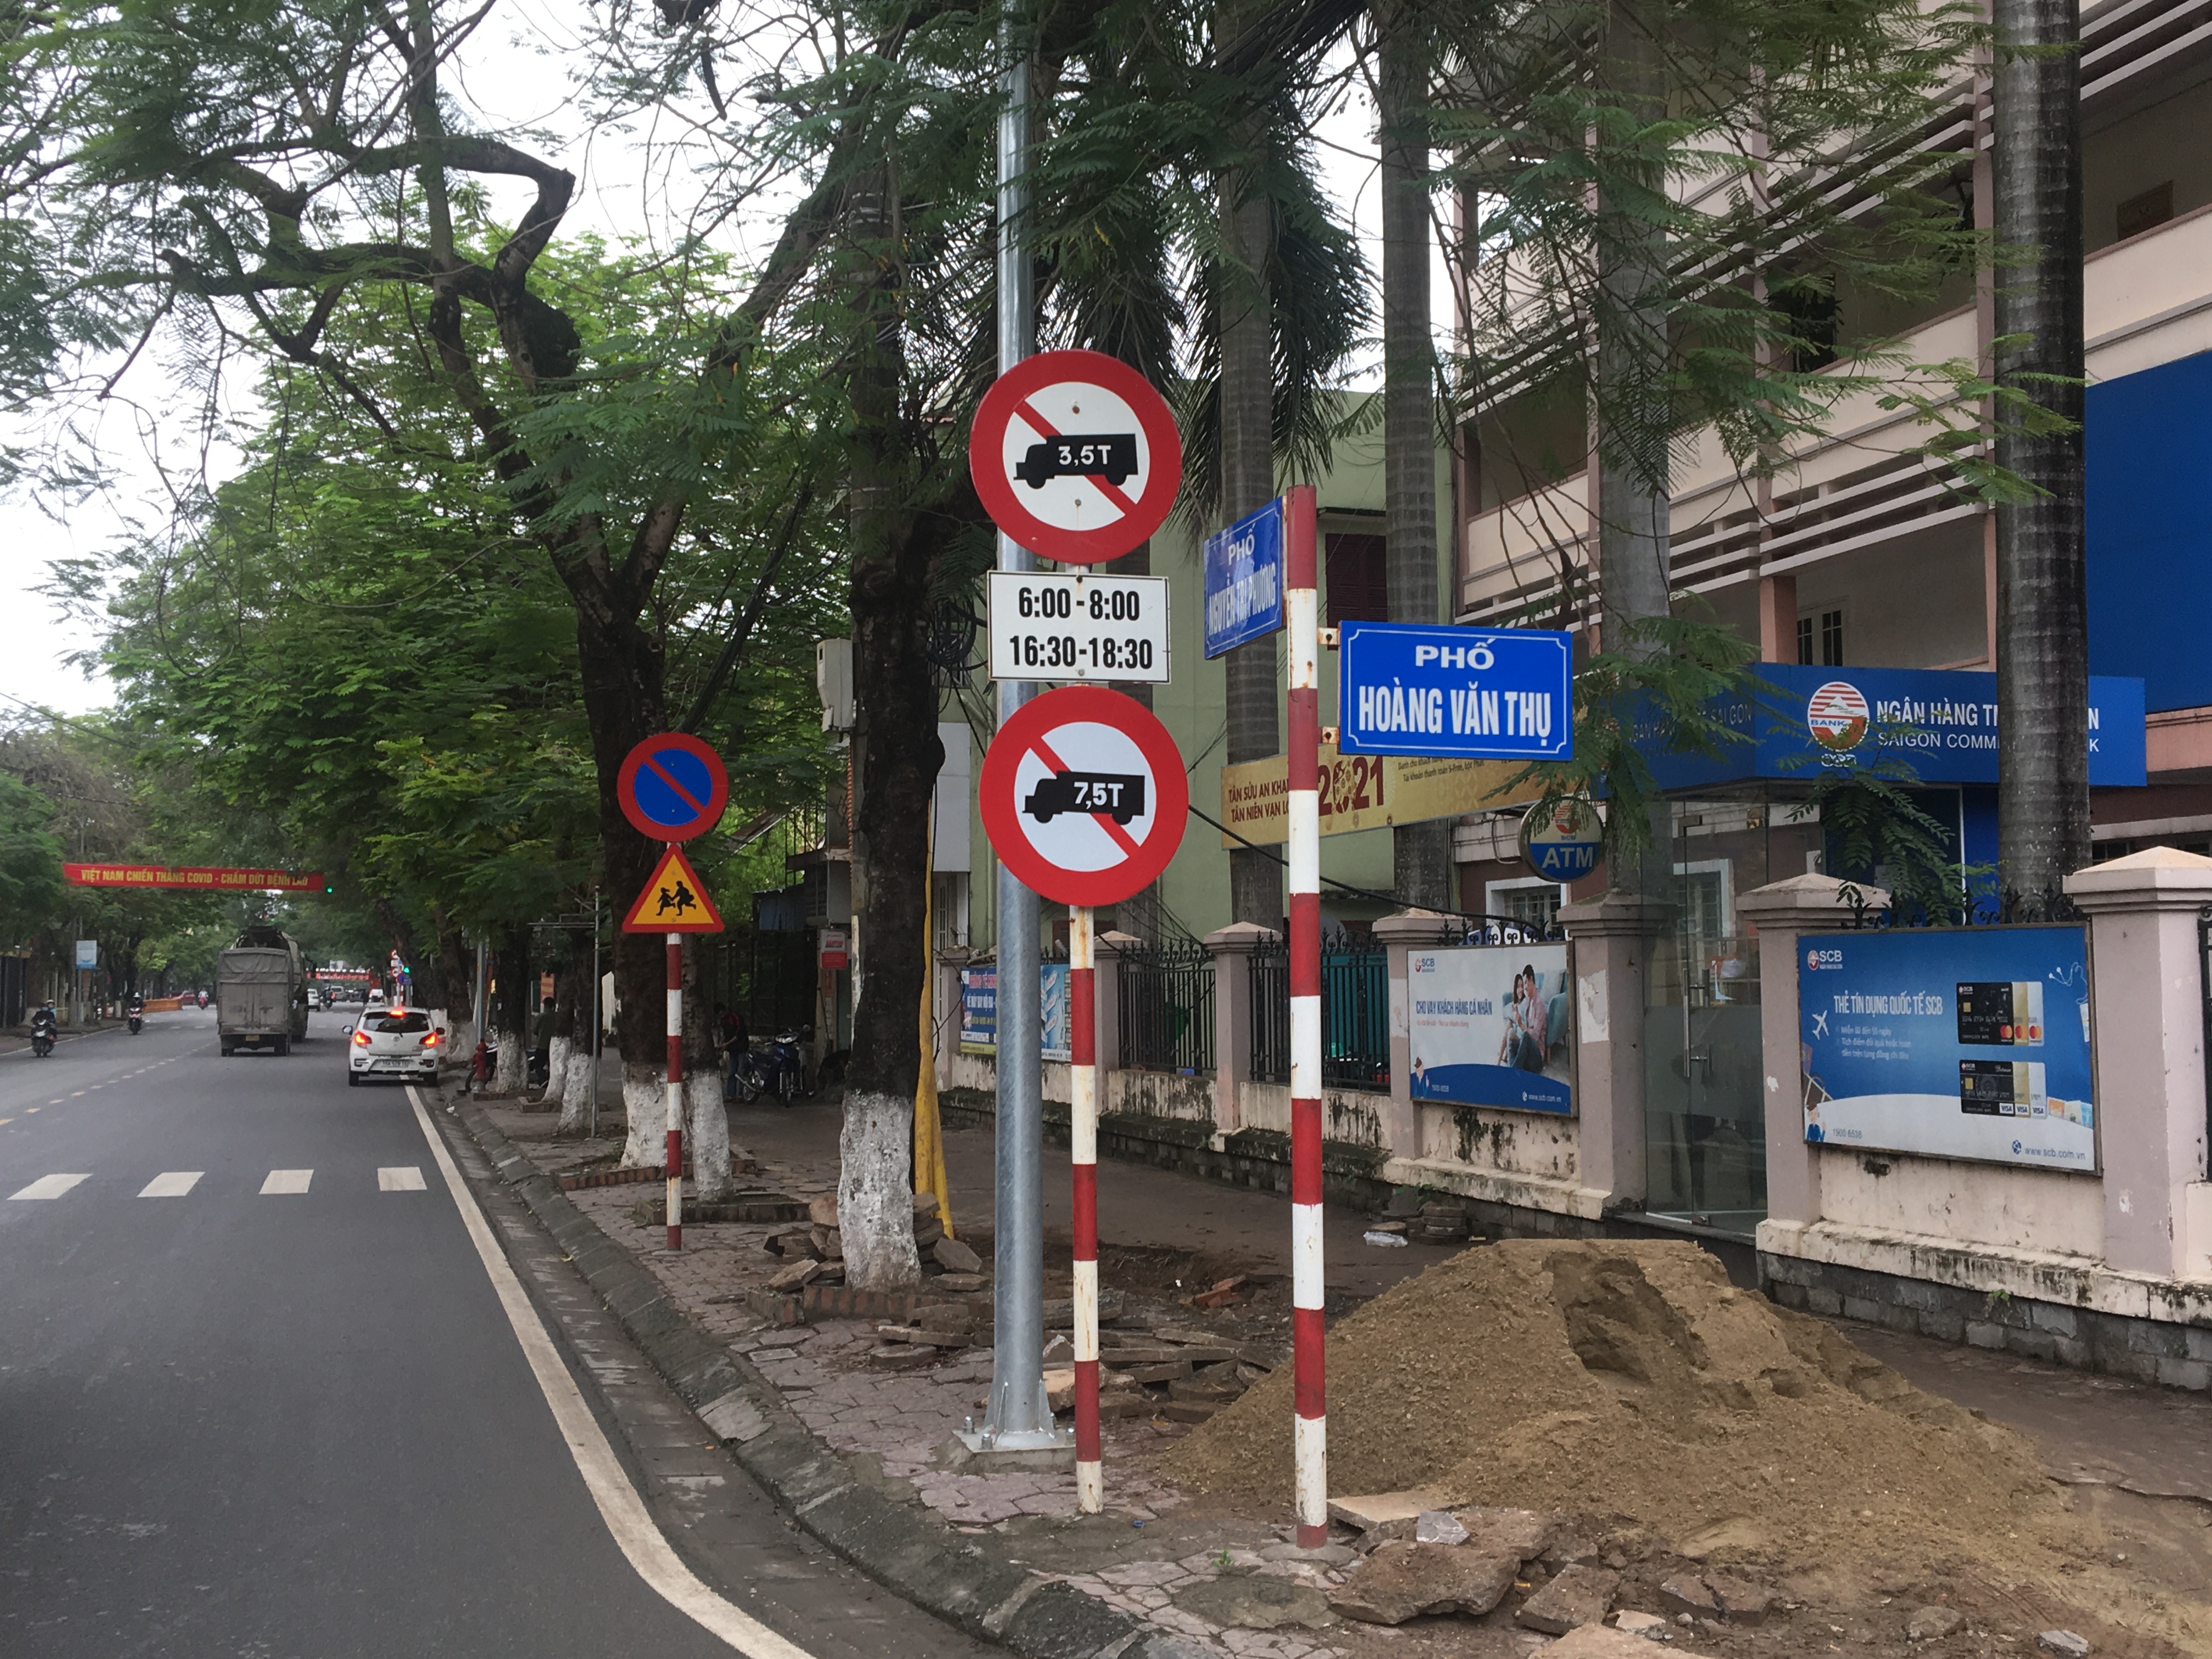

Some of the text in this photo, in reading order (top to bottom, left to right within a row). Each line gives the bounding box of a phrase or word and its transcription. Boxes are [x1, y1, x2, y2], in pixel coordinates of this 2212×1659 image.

[1058, 445, 1111, 466] 3,5T
[1228, 522, 1255, 566] PHỐ
[1415, 638, 1496, 670] PHỐ
[1359, 676, 1551, 746] HOÀNG VĂN THỤ
[1877, 696, 1925, 724] NGÂN
[1930, 697, 1978, 726] HÀNG
[1877, 732, 1941, 747] SAIGON
[1074, 782, 1124, 809] 7,5T
[1229, 784, 1243, 803] TÂN
[1259, 783, 1270, 797] AN
[1271, 778, 1289, 795] KHA
[1231, 805, 1245, 822] TÂN
[1542, 847, 1594, 868] ATM
[81, 867, 101, 883] VIỆT
[103, 871, 124, 881] NAM
[187, 872, 213, 883] COVID
[1421, 958, 1435, 967] SCB
[1819, 950, 1842, 962] SCB
[1833, 990, 1943, 1018] THẺ TÍN DỤNG QUỐC TẾ SCB
